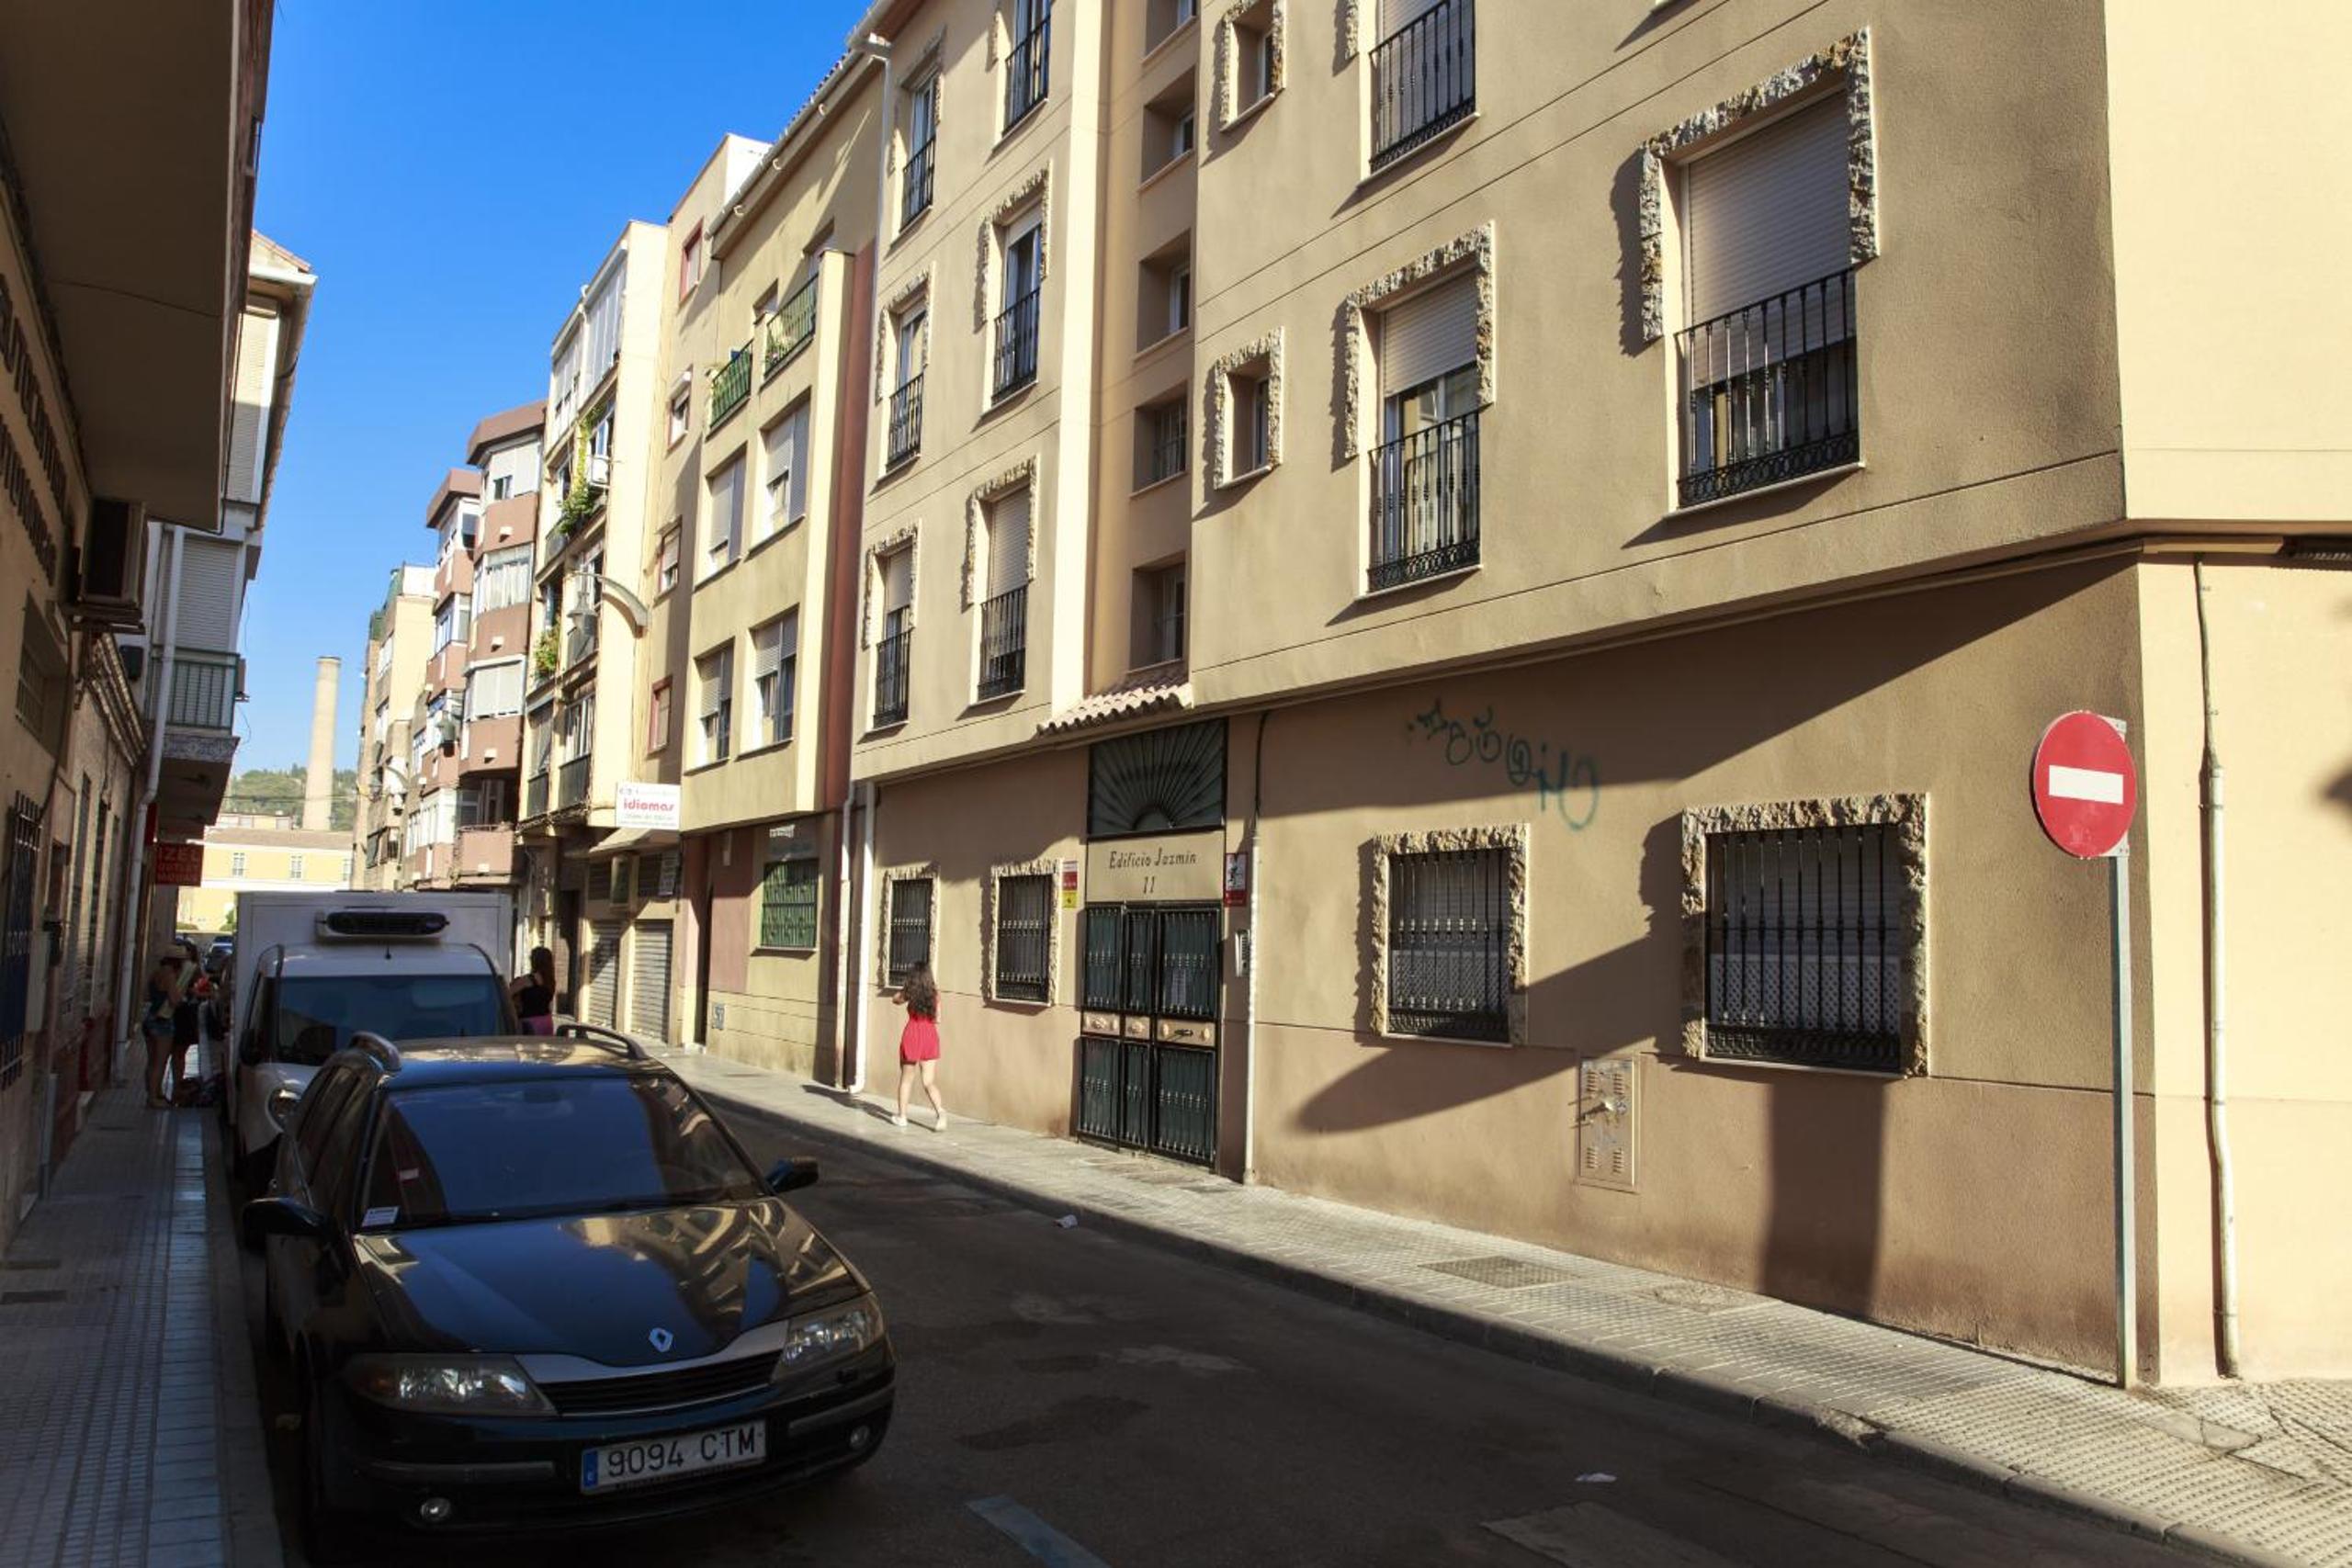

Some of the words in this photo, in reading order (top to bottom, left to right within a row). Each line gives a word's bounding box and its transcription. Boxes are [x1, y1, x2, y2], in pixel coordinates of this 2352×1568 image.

[624, 798, 674, 811] idiomas
[1109, 851, 1152, 869] Edificio
[606, 1440, 684, 1477] 9094
[700, 1427, 754, 1461] CTM
